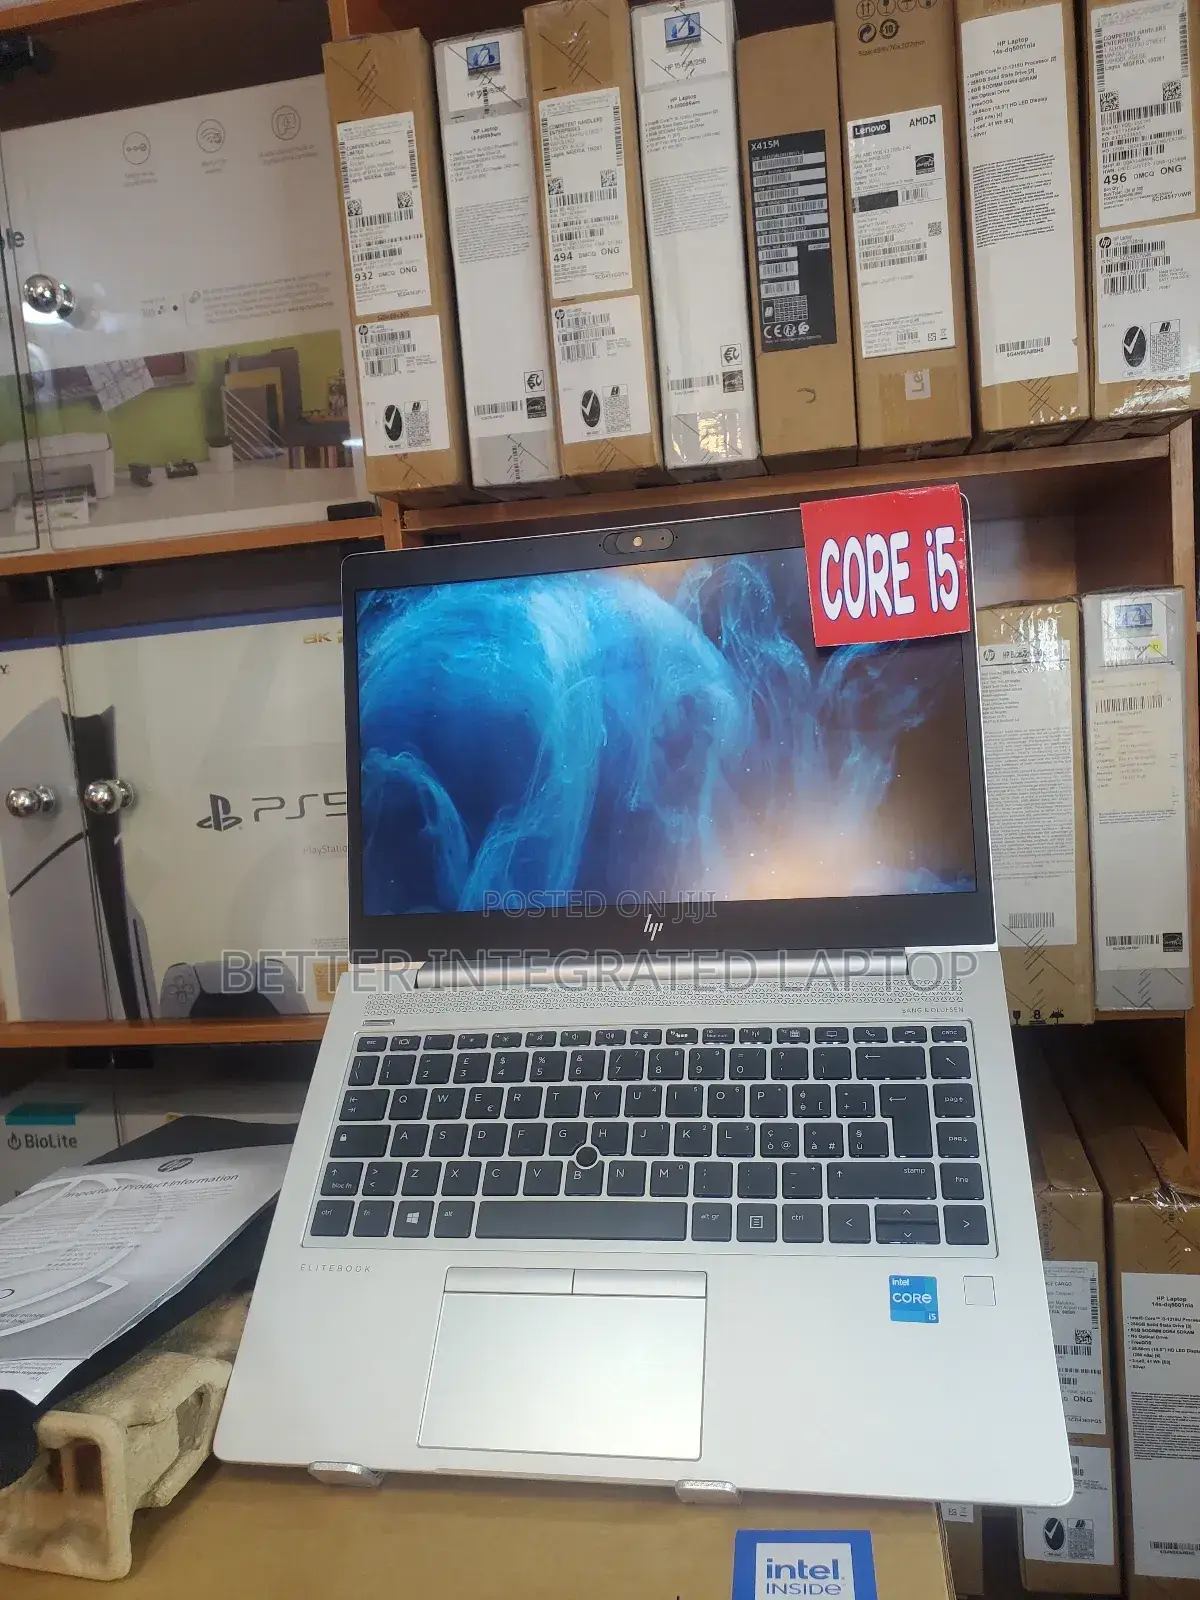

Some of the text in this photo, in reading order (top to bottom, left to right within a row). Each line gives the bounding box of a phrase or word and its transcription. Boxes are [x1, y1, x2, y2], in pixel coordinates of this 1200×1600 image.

[1007, 37, 1029, 46] Laptop
[909, 116, 929, 127] AMD
[854, 123, 887, 136] Lenovo
[751, 140, 780, 151] X415M
[1103, 172, 1127, 185] 496
[1160, 165, 1182, 175] ONG
[553, 251, 573, 262] 494
[601, 247, 620, 255] ONG
[354, 271, 373, 281] 932
[399, 265, 418, 275] ONG
[820, 526, 960, 621] CORE i5
[303, 844, 347, 856] PlayStatio
[500, 1057, 506, 1065] $
[538, 1056, 546, 1064] %
[422, 1070, 429, 1078] 2
[460, 1069, 467, 1077] 3
[498, 1068, 505, 1076] 4
[536, 1068, 543, 1076] 5
[575, 1067, 582, 1075] 6
[615, 1066, 622, 1074] 7
[655, 1066, 662, 1074] 8
[696, 1066, 702, 1074] 9
[398, 1095, 408, 1104] Q
[437, 1094, 449, 1103] W
[474, 1093, 482, 1102] E
[513, 1093, 521, 1102] R
[553, 1092, 560, 1100] T
[593, 1091, 601, 1100] Y
[633, 1091, 641, 1100] U
[757, 1092, 765, 1100] P
[400, 1131, 408, 1140] A
[439, 1131, 447, 1140] S
[477, 1130, 486, 1139] D
[517, 1130, 525, 1138] F
[559, 1129, 567, 1138] G
[599, 1129, 607, 1138] H
[640, 1129, 647, 1138] J
[682, 1130, 691, 1138] K
[725, 1130, 732, 1139] L
[24, 1132, 78, 1150] BioLite
[781, 1140, 791, 1150] @
[411, 1169, 419, 1178] Z
[451, 1169, 459, 1178] X
[492, 1169, 500, 1177] C
[533, 1168, 542, 1177] V
[574, 1170, 582, 1180] B
[616, 1168, 624, 1177] N
[659, 1169, 669, 1178] M
[904, 1167, 926, 1175] stamp
[63, 1174, 240, 1199] Important Product Information
[300, 1264, 372, 1273] ELITEBOOK
[892, 1278, 910, 1286] intel
[928, 1313, 937, 1321] i5
[766, 1558, 841, 1580] intel
